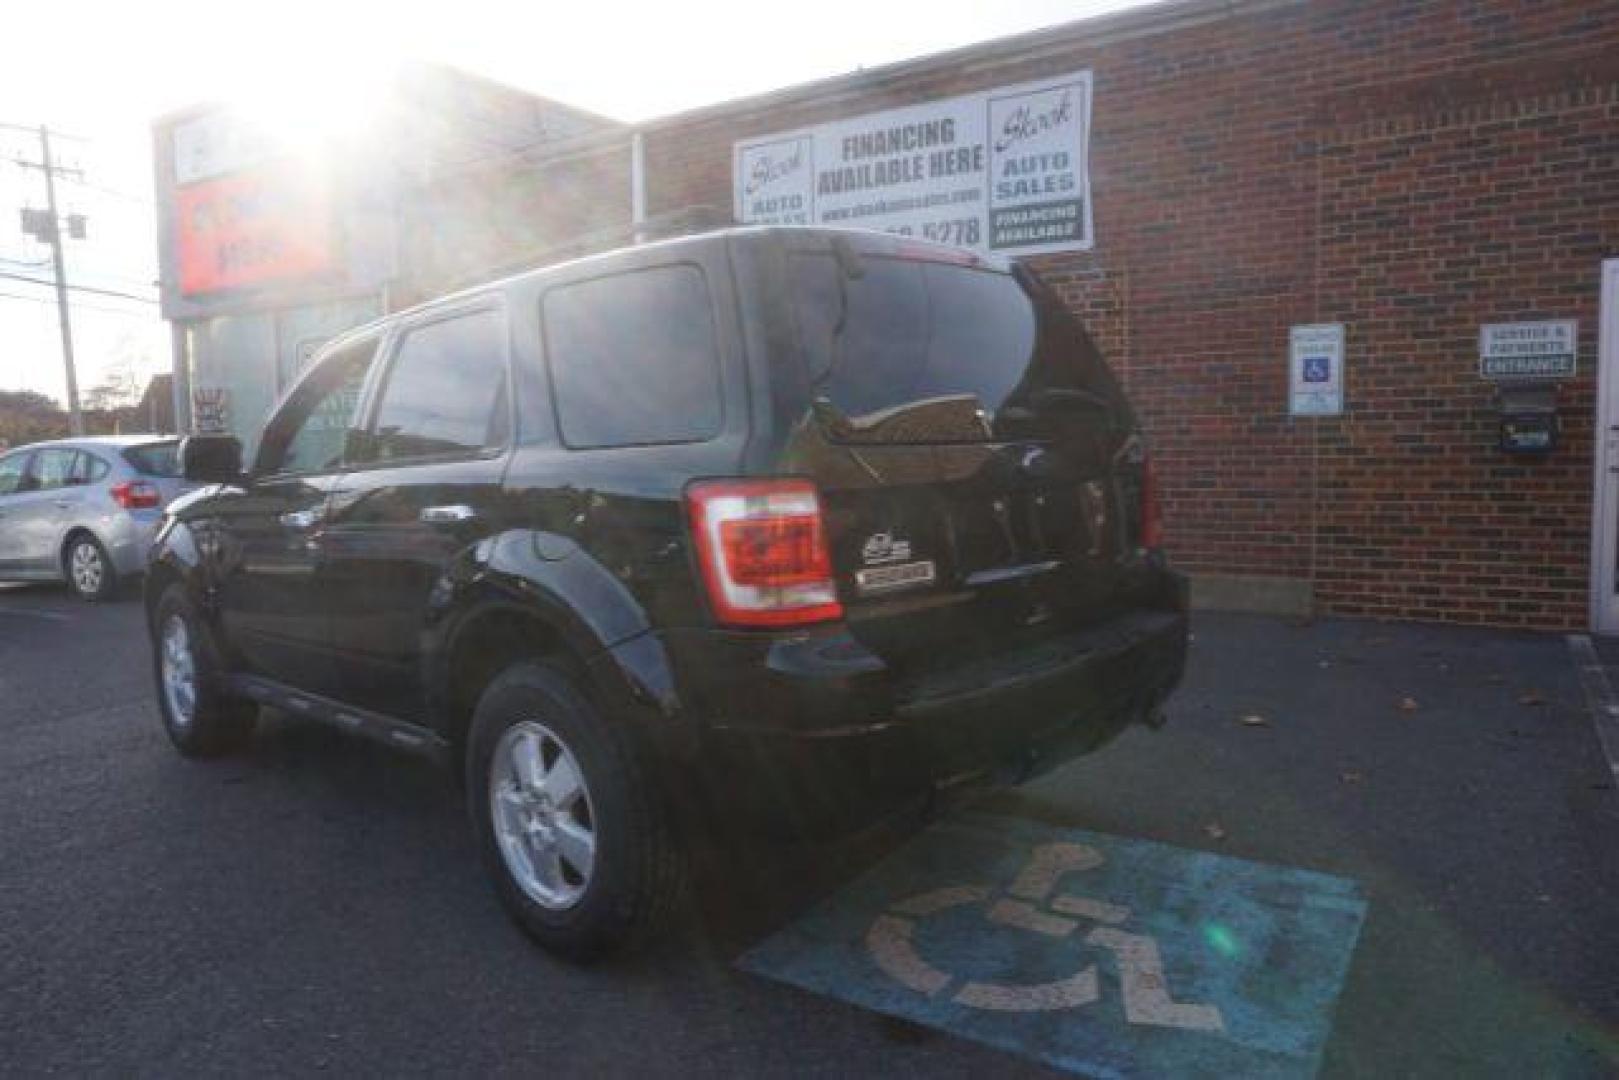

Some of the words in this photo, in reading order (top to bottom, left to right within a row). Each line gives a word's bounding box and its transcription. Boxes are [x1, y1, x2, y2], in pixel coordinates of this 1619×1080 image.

[842, 118, 955, 161] FINANCING
[818, 152, 924, 195] AVAILABLE
[929, 144, 983, 178] HERE
[1003, 152, 1068, 177] AUTO
[996, 173, 1074, 199] SALES
[752, 195, 803, 215] AUTO
[995, 204, 1076, 227] FINANCING
[995, 222, 1075, 244] AVAILABLE
[1488, 356, 1569, 374] ENTRANCE
